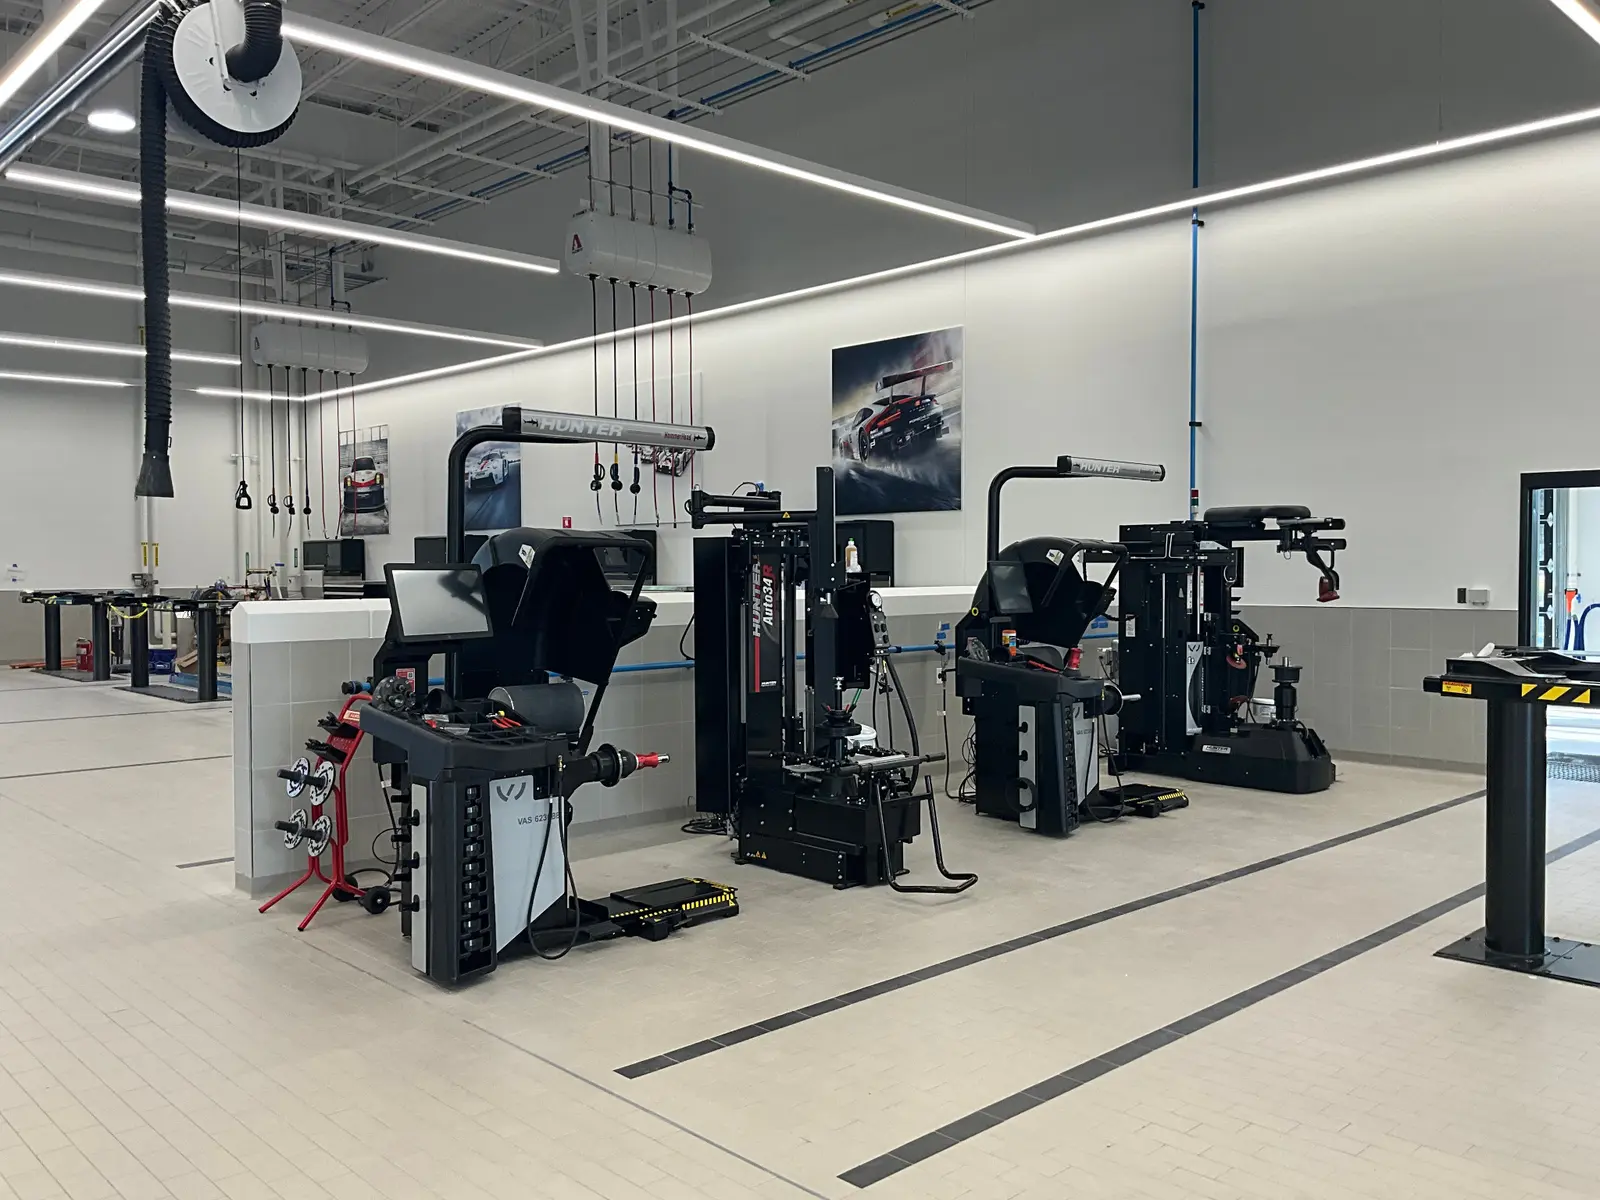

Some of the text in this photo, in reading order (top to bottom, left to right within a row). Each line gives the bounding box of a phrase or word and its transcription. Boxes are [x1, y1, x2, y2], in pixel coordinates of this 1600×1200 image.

[539, 417, 624, 437] HUNTER
[1080, 463, 1120, 474] HUNTER
[752, 562, 761, 637] HUNTER
[762, 564, 774, 626] Auto34R
[517, 816, 533, 825] VAS
